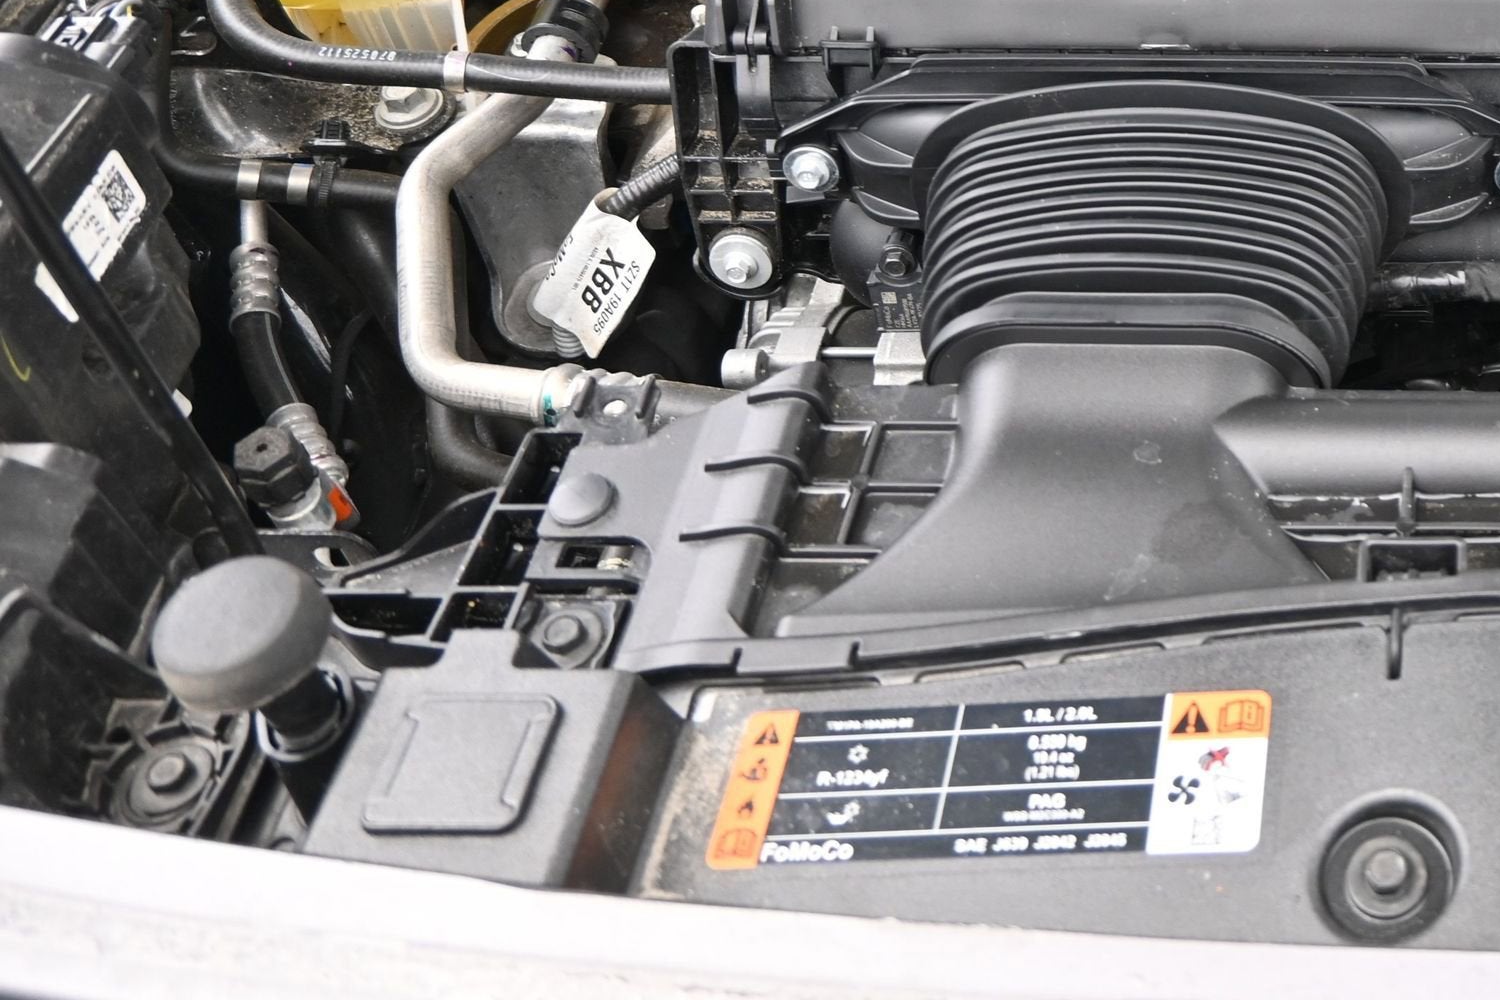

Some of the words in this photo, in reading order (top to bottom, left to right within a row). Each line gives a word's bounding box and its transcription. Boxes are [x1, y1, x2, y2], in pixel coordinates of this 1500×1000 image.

[581, 247, 626, 314] XBB
[816, 768, 890, 787] R-1234yf
[760, 839, 855, 863] FoMoCo
[953, 837, 988, 853] SAE
